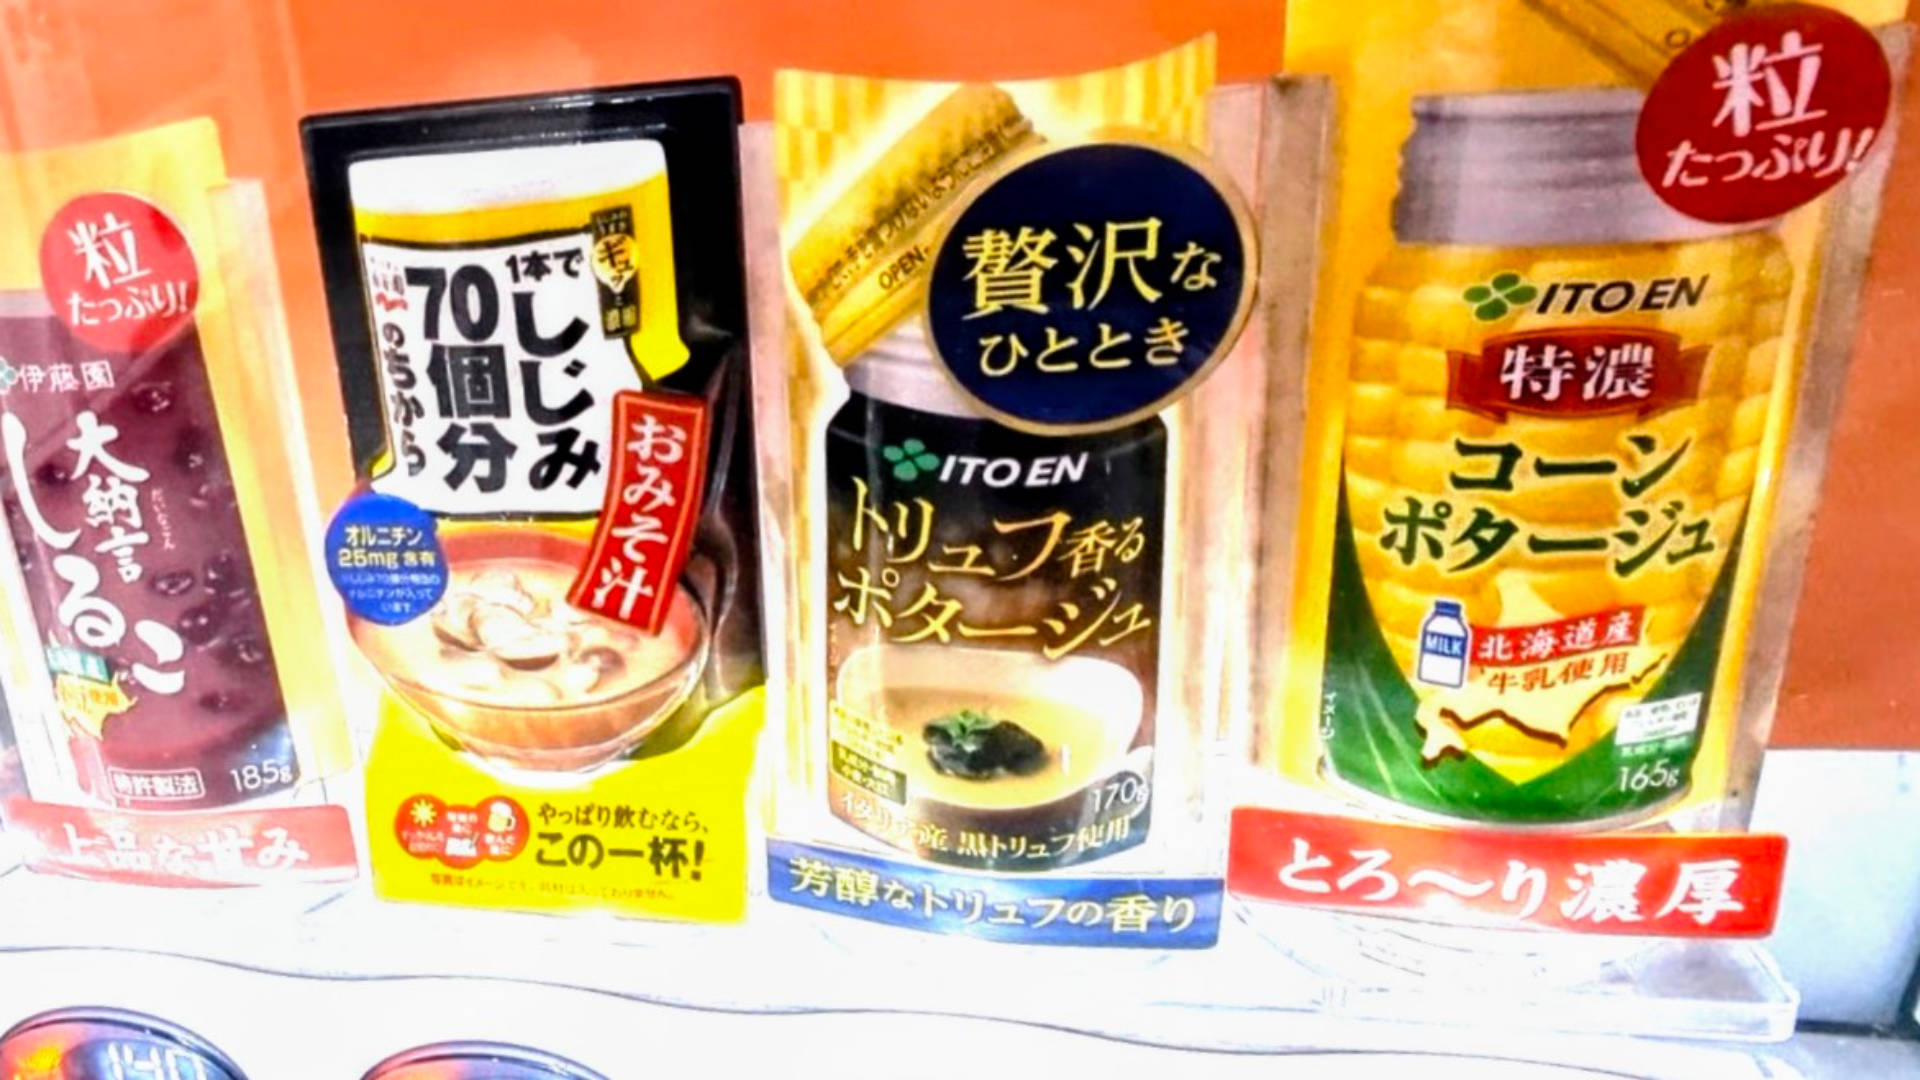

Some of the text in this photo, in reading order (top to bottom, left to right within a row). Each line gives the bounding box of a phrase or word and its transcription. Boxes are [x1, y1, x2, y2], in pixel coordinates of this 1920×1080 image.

[1712, 30, 1827, 137] 粒
[66, 211, 152, 290] 粒
[505, 246, 584, 284] 1本で
[878, 244, 928, 291] OPEN
[960, 216, 1224, 319] 贅沢な
[67, 281, 190, 326] たっぷり!
[1536, 273, 1711, 315] ITO EN
[977, 316, 1191, 377] ひととき
[1500, 342, 1655, 401] 特濃
[18, 359, 116, 393] 伊藤園
[404, 264, 518, 494] 70個分
[512, 290, 602, 492] しじみ
[939, 452, 1089, 488] ITO EN
[1448, 433, 1692, 498] コーン
[66, 410, 151, 584] 大納言
[592, 414, 687, 620] おみそ汁
[344, 523, 424, 547] オルニチン
[851, 475, 1146, 582] トリュフ香る
[1379, 496, 1715, 577] ポタージュ
[337, 547, 400, 571] 25mg
[834, 566, 1152, 661] ポタージュ
[1478, 610, 1636, 661] 北海道産
[1426, 634, 1463, 656] MILK
[1487, 651, 1630, 696] 牛乳使用
[229, 757, 294, 793] 185g
[1620, 757, 1680, 793] 165g
[537, 802, 708, 834] やっぱり飲むなら、
[535, 831, 705, 881] この一杯!
[789, 856, 1196, 935] 芳醇なトリュフの香り
